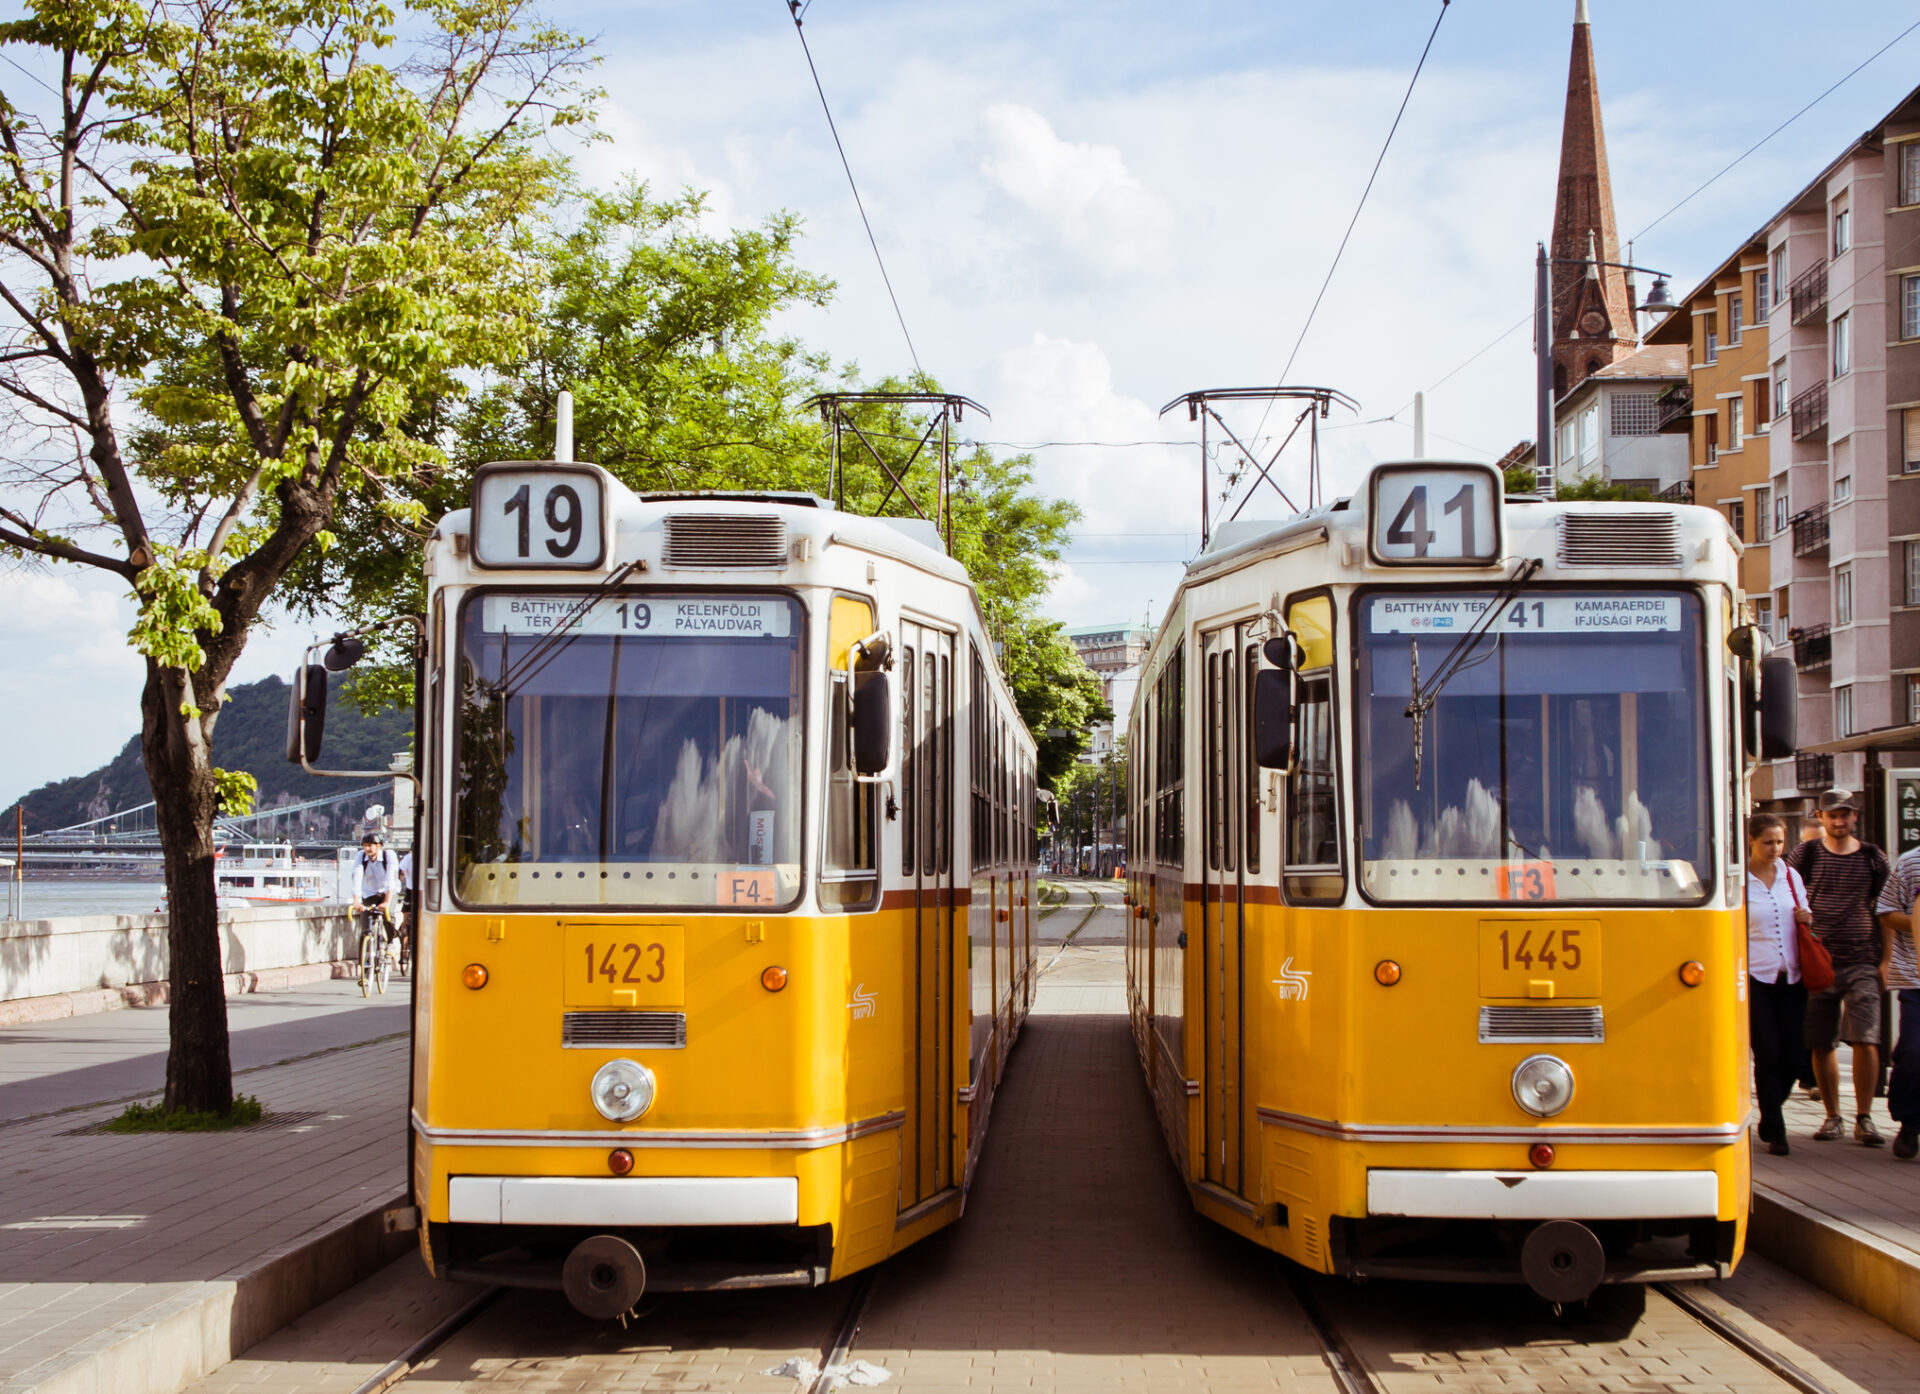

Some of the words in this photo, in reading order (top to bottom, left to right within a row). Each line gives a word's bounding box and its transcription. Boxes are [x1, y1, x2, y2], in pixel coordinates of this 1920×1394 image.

[503, 484, 582, 558] 19
[1387, 484, 1476, 557] 41
[511, 600, 592, 614] BATTHYÁNY
[617, 603, 651, 630] 19
[677, 603, 760, 617] KELENFÖLDI
[1385, 600, 1460, 613] BATTHYÁNY
[1464, 600, 1487, 612] TÉR
[1508, 601, 1544, 628] 41
[1575, 601, 1665, 611] KAMARAERDEI
[524, 614, 552, 627] TÉR
[675, 616, 762, 630] PÁLYAUDVAR
[1575, 613, 1632, 626] IFJÚSÁGI
[1636, 615, 1668, 625] PARK
[732, 879, 760, 903] F4
[1508, 867, 1544, 900] F3
[1499, 929, 1582, 970] 1445
[585, 943, 665, 984] 1423
